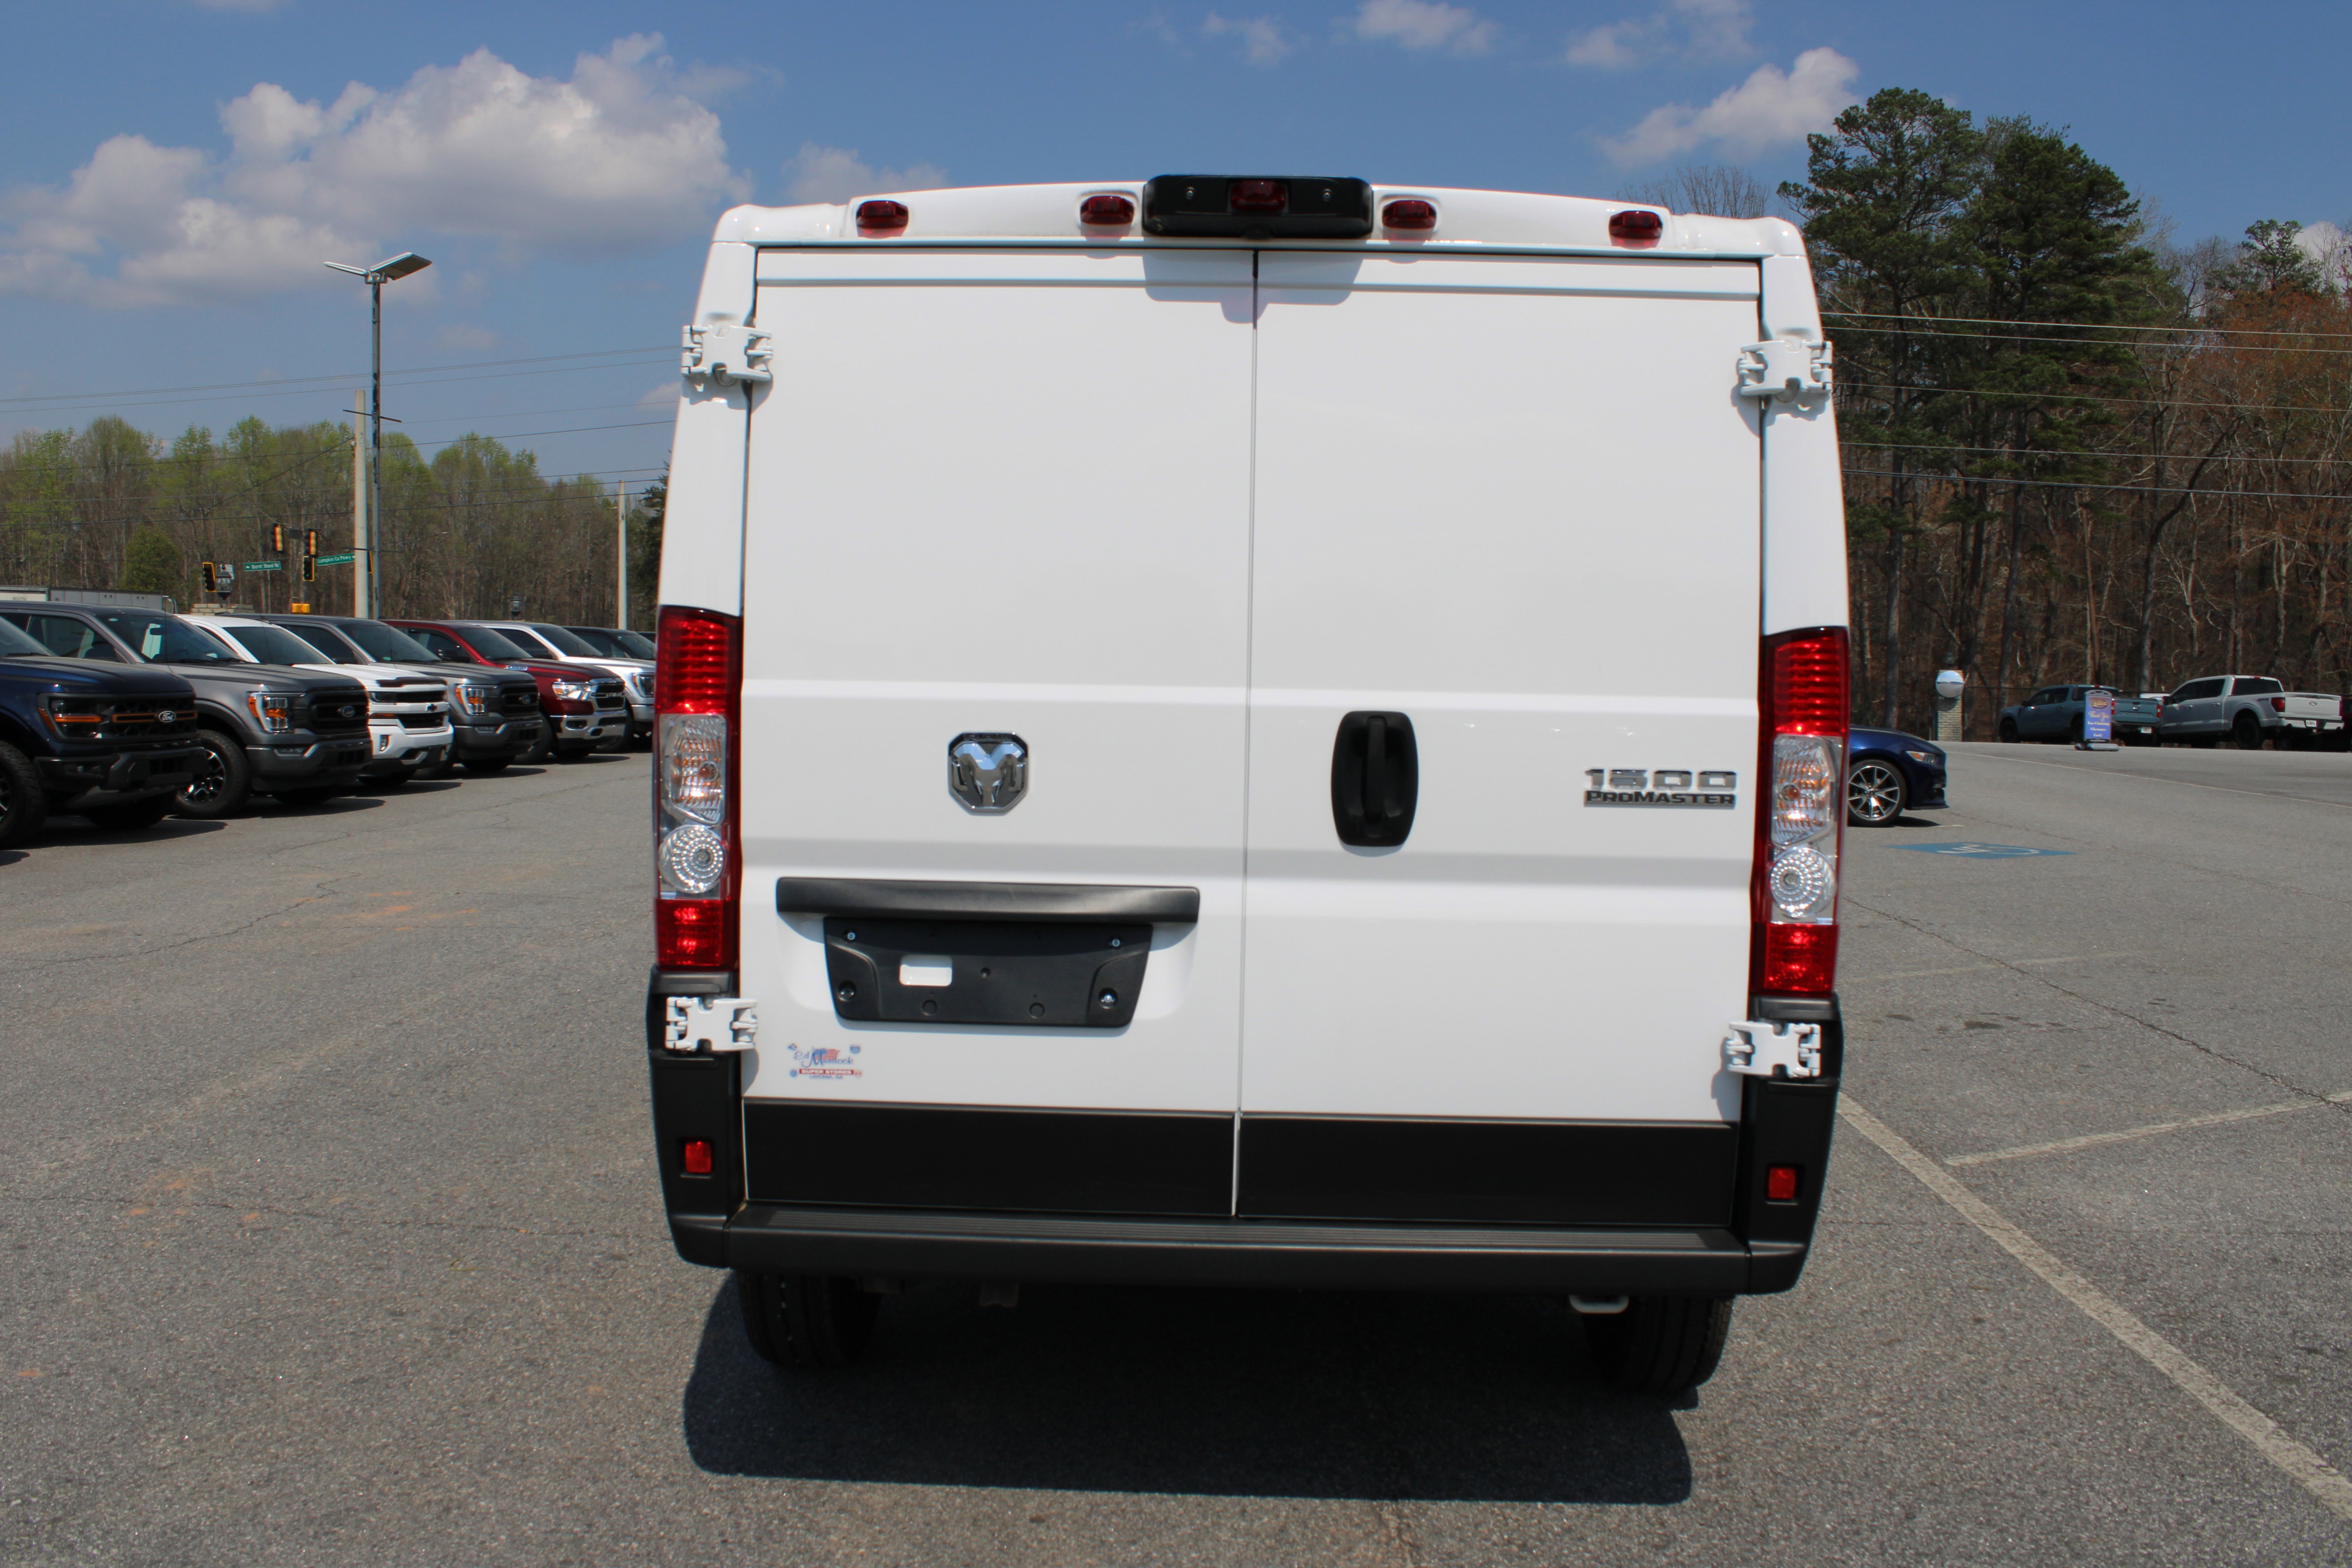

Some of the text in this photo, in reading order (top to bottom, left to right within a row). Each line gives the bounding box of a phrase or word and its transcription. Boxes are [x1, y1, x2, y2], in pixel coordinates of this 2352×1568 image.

[1585, 769, 1737, 791] 1500
[1586, 791, 1735, 805] PROMASTER
[794, 1051, 810, 1060] Ed
[801, 1050, 853, 1068] Murdock
